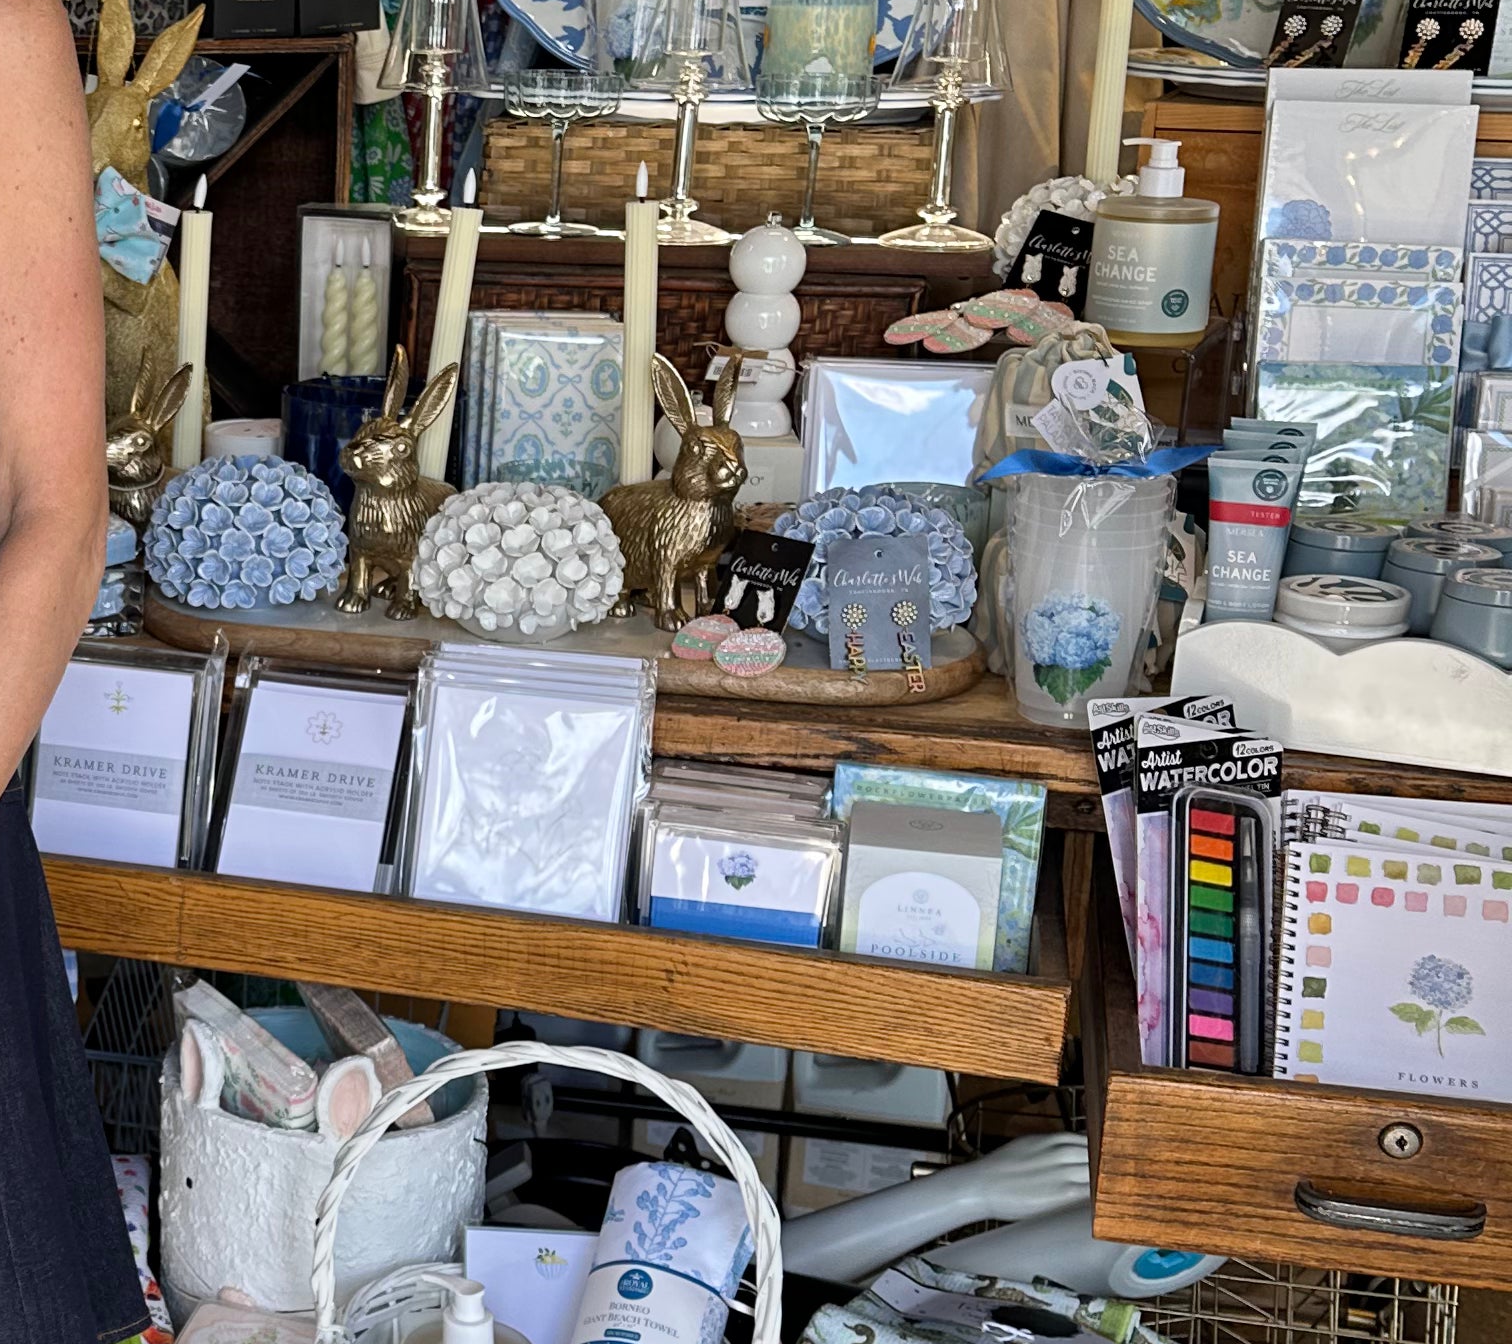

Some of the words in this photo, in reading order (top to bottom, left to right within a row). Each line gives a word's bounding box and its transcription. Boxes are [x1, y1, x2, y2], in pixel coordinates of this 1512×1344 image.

[1336, 78, 1368, 98] The
[1339, 112, 1370, 133] The
[1107, 244, 1139, 263] SEA
[1094, 262, 1158, 284] CHANGE
[1250, 509, 1282, 520] TESTER
[1227, 549, 1258, 565] SEA
[1211, 564, 1273, 583] CHANGE
[845, 632, 870, 686] HAPPY
[897, 631, 927, 694] EASTER
[1197, 699, 1226, 715] COLORS
[1142, 721, 1181, 740] ArtSkills
[1141, 749, 1183, 770] Artist
[1246, 744, 1275, 755] COLORS
[53, 756, 115, 774] KRAMER
[122, 763, 168, 779] DRIVE
[255, 763, 320, 782] KRAMER
[328, 772, 376, 788] DRIVE
[1139, 757, 1279, 793] WATERCOLOR
[870, 942, 962, 963] POOLSIDE
[1398, 1072, 1479, 1089] FLOWERS
[608, 1301, 650, 1316] BORNEO
[608, 1312, 641, 1325] BEACH
[643, 1318, 680, 1340] TOWEL
